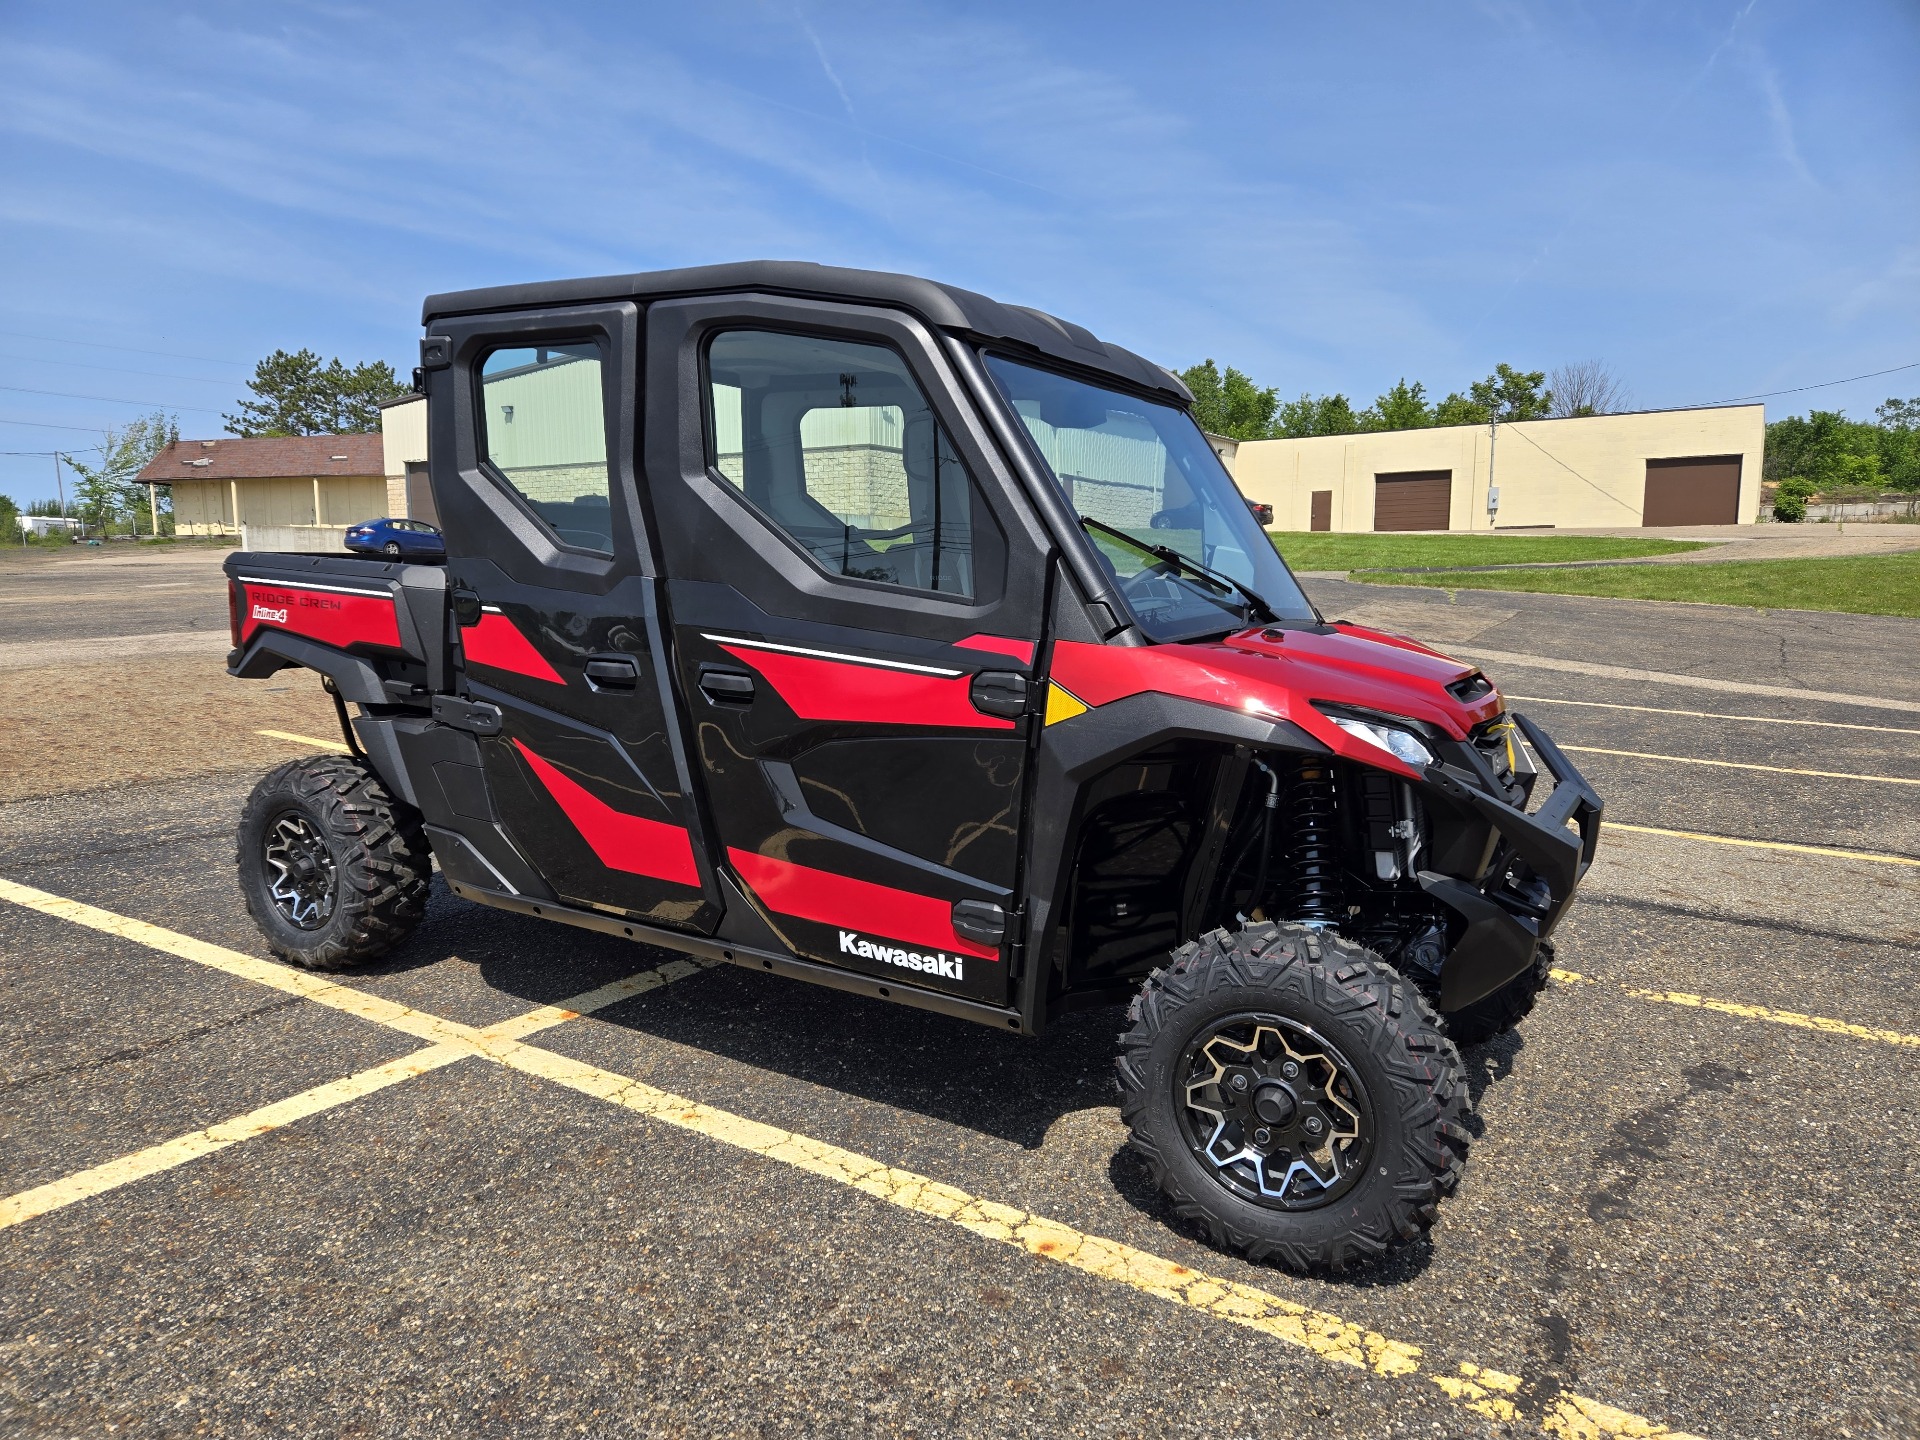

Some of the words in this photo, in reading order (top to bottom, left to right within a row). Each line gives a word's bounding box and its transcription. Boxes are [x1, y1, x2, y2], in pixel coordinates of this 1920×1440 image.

[252, 592, 295, 605] RIDGE
[299, 597, 341, 610] CREW
[839, 931, 963, 980] Kawasaki
